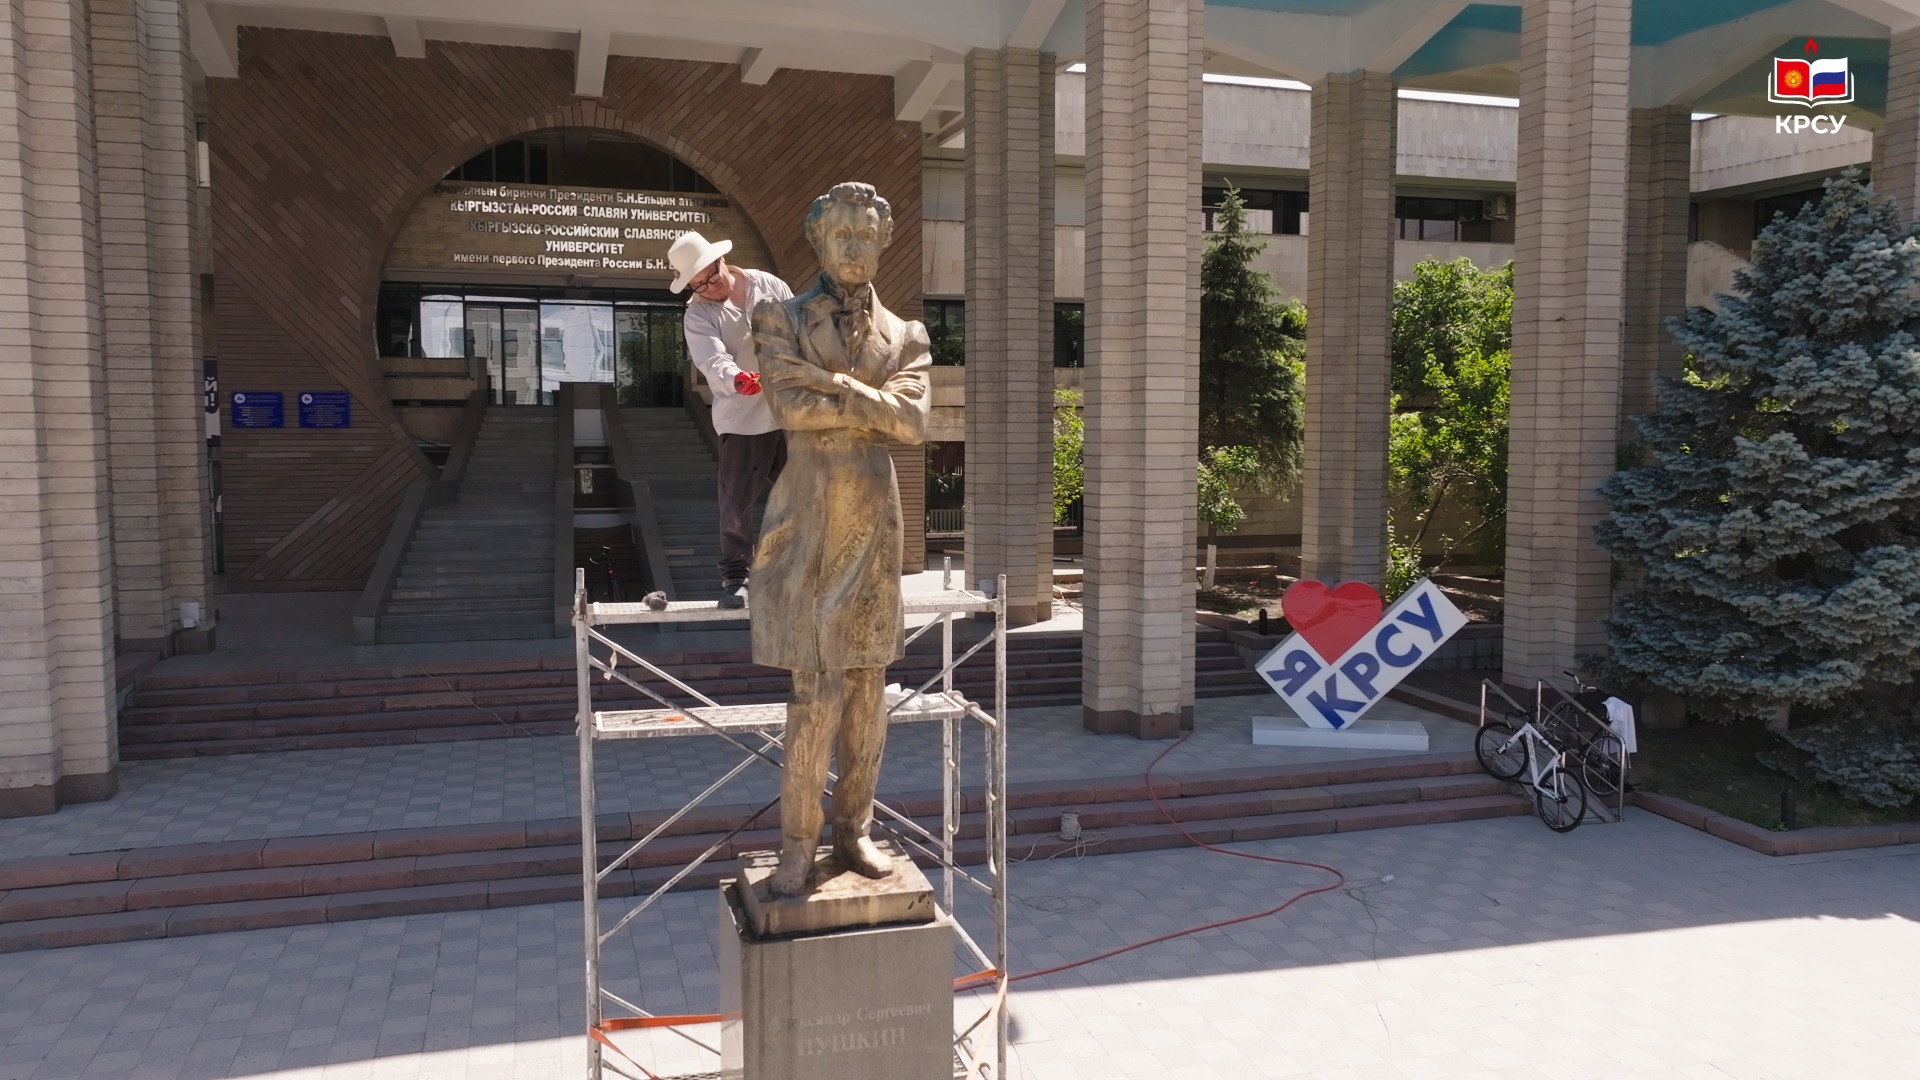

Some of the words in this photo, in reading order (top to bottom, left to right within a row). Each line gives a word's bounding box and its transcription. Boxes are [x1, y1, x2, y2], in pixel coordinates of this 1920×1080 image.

[499, 186, 547, 200] биринчи
[549, 188, 614, 203] Президенти
[450, 200, 578, 217] КЫРГЫЗСТАН-РОССИЯ
[583, 206, 629, 220] СЛАВЯН
[545, 240, 625, 255] УНИВЕРСИТЕТ
[453, 253, 490, 264] имени
[492, 255, 536, 267] первого
[537, 255, 601, 269] Президента
[602, 257, 643, 270] России
[1306, 591, 1444, 730] КРСУ
[1266, 649, 1322, 697] Я
[797, 1027, 906, 1057] ПУШКИН
